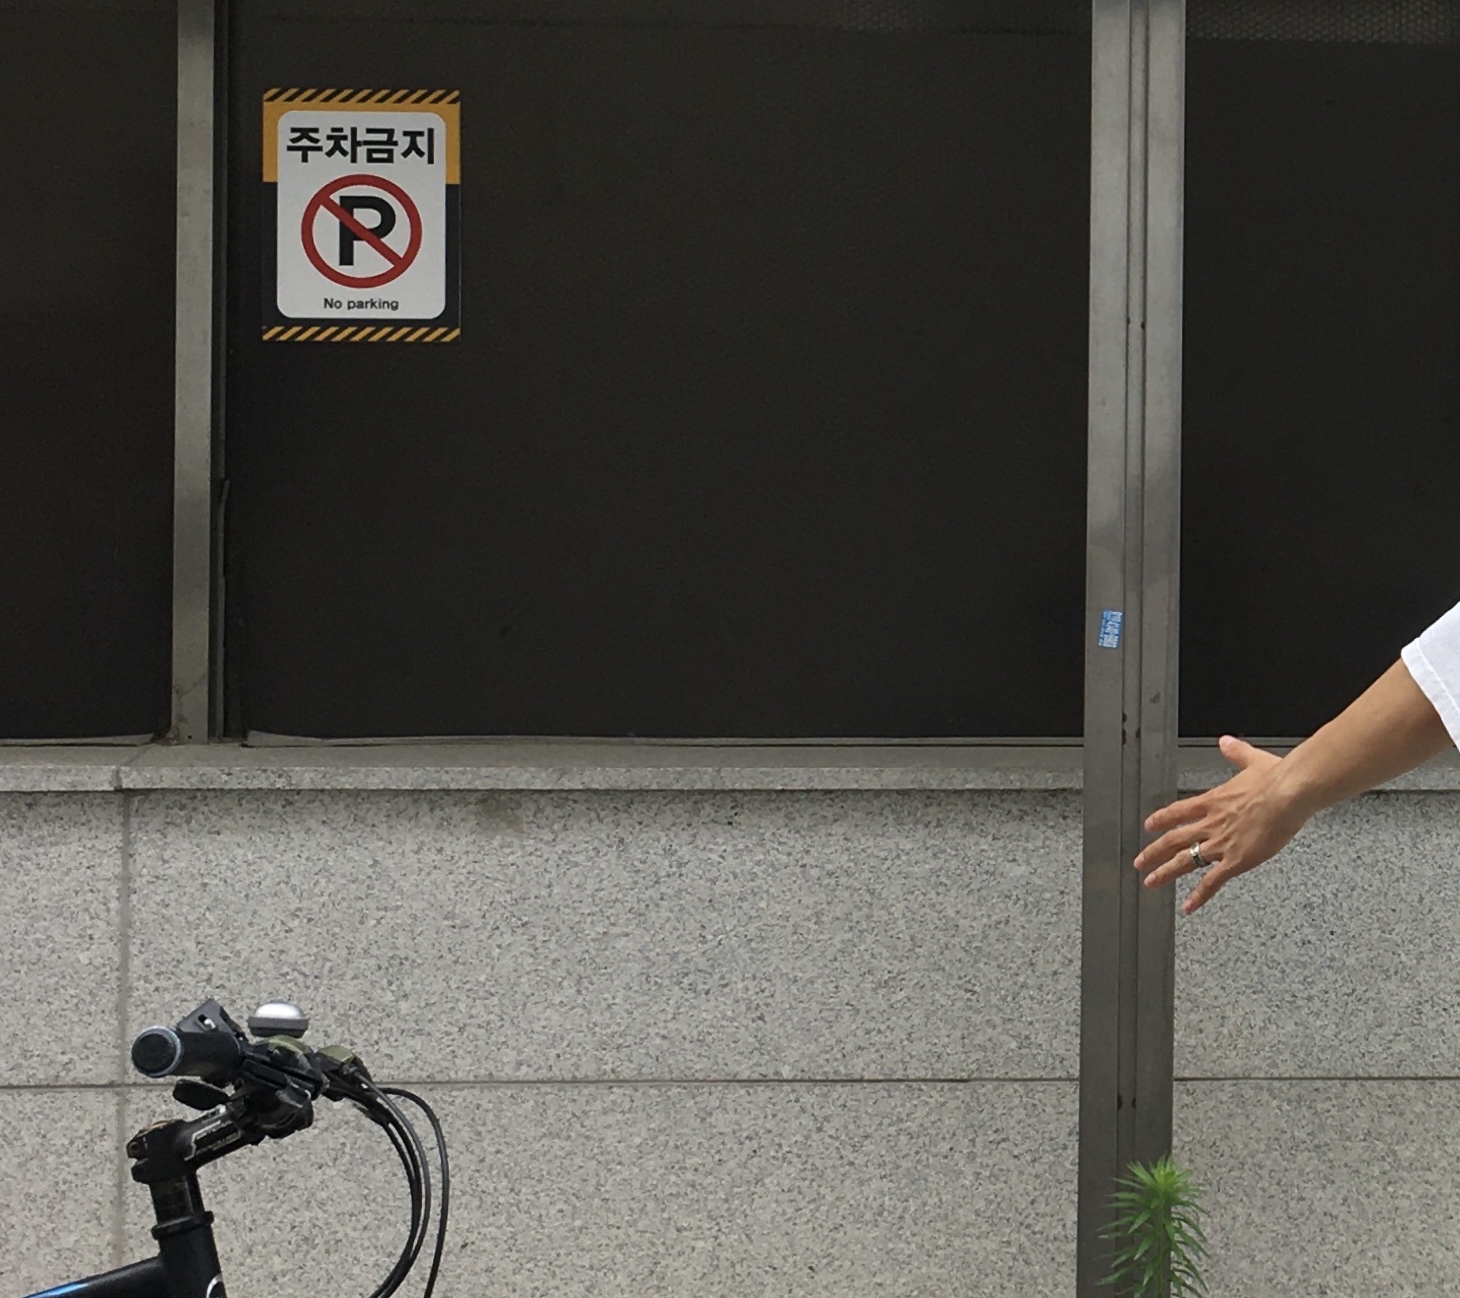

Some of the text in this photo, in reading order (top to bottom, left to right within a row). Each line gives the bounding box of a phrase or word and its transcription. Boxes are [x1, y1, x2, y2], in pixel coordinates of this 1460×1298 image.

[286, 126, 435, 165] 주차금지
[323, 298, 399, 311] No parking
